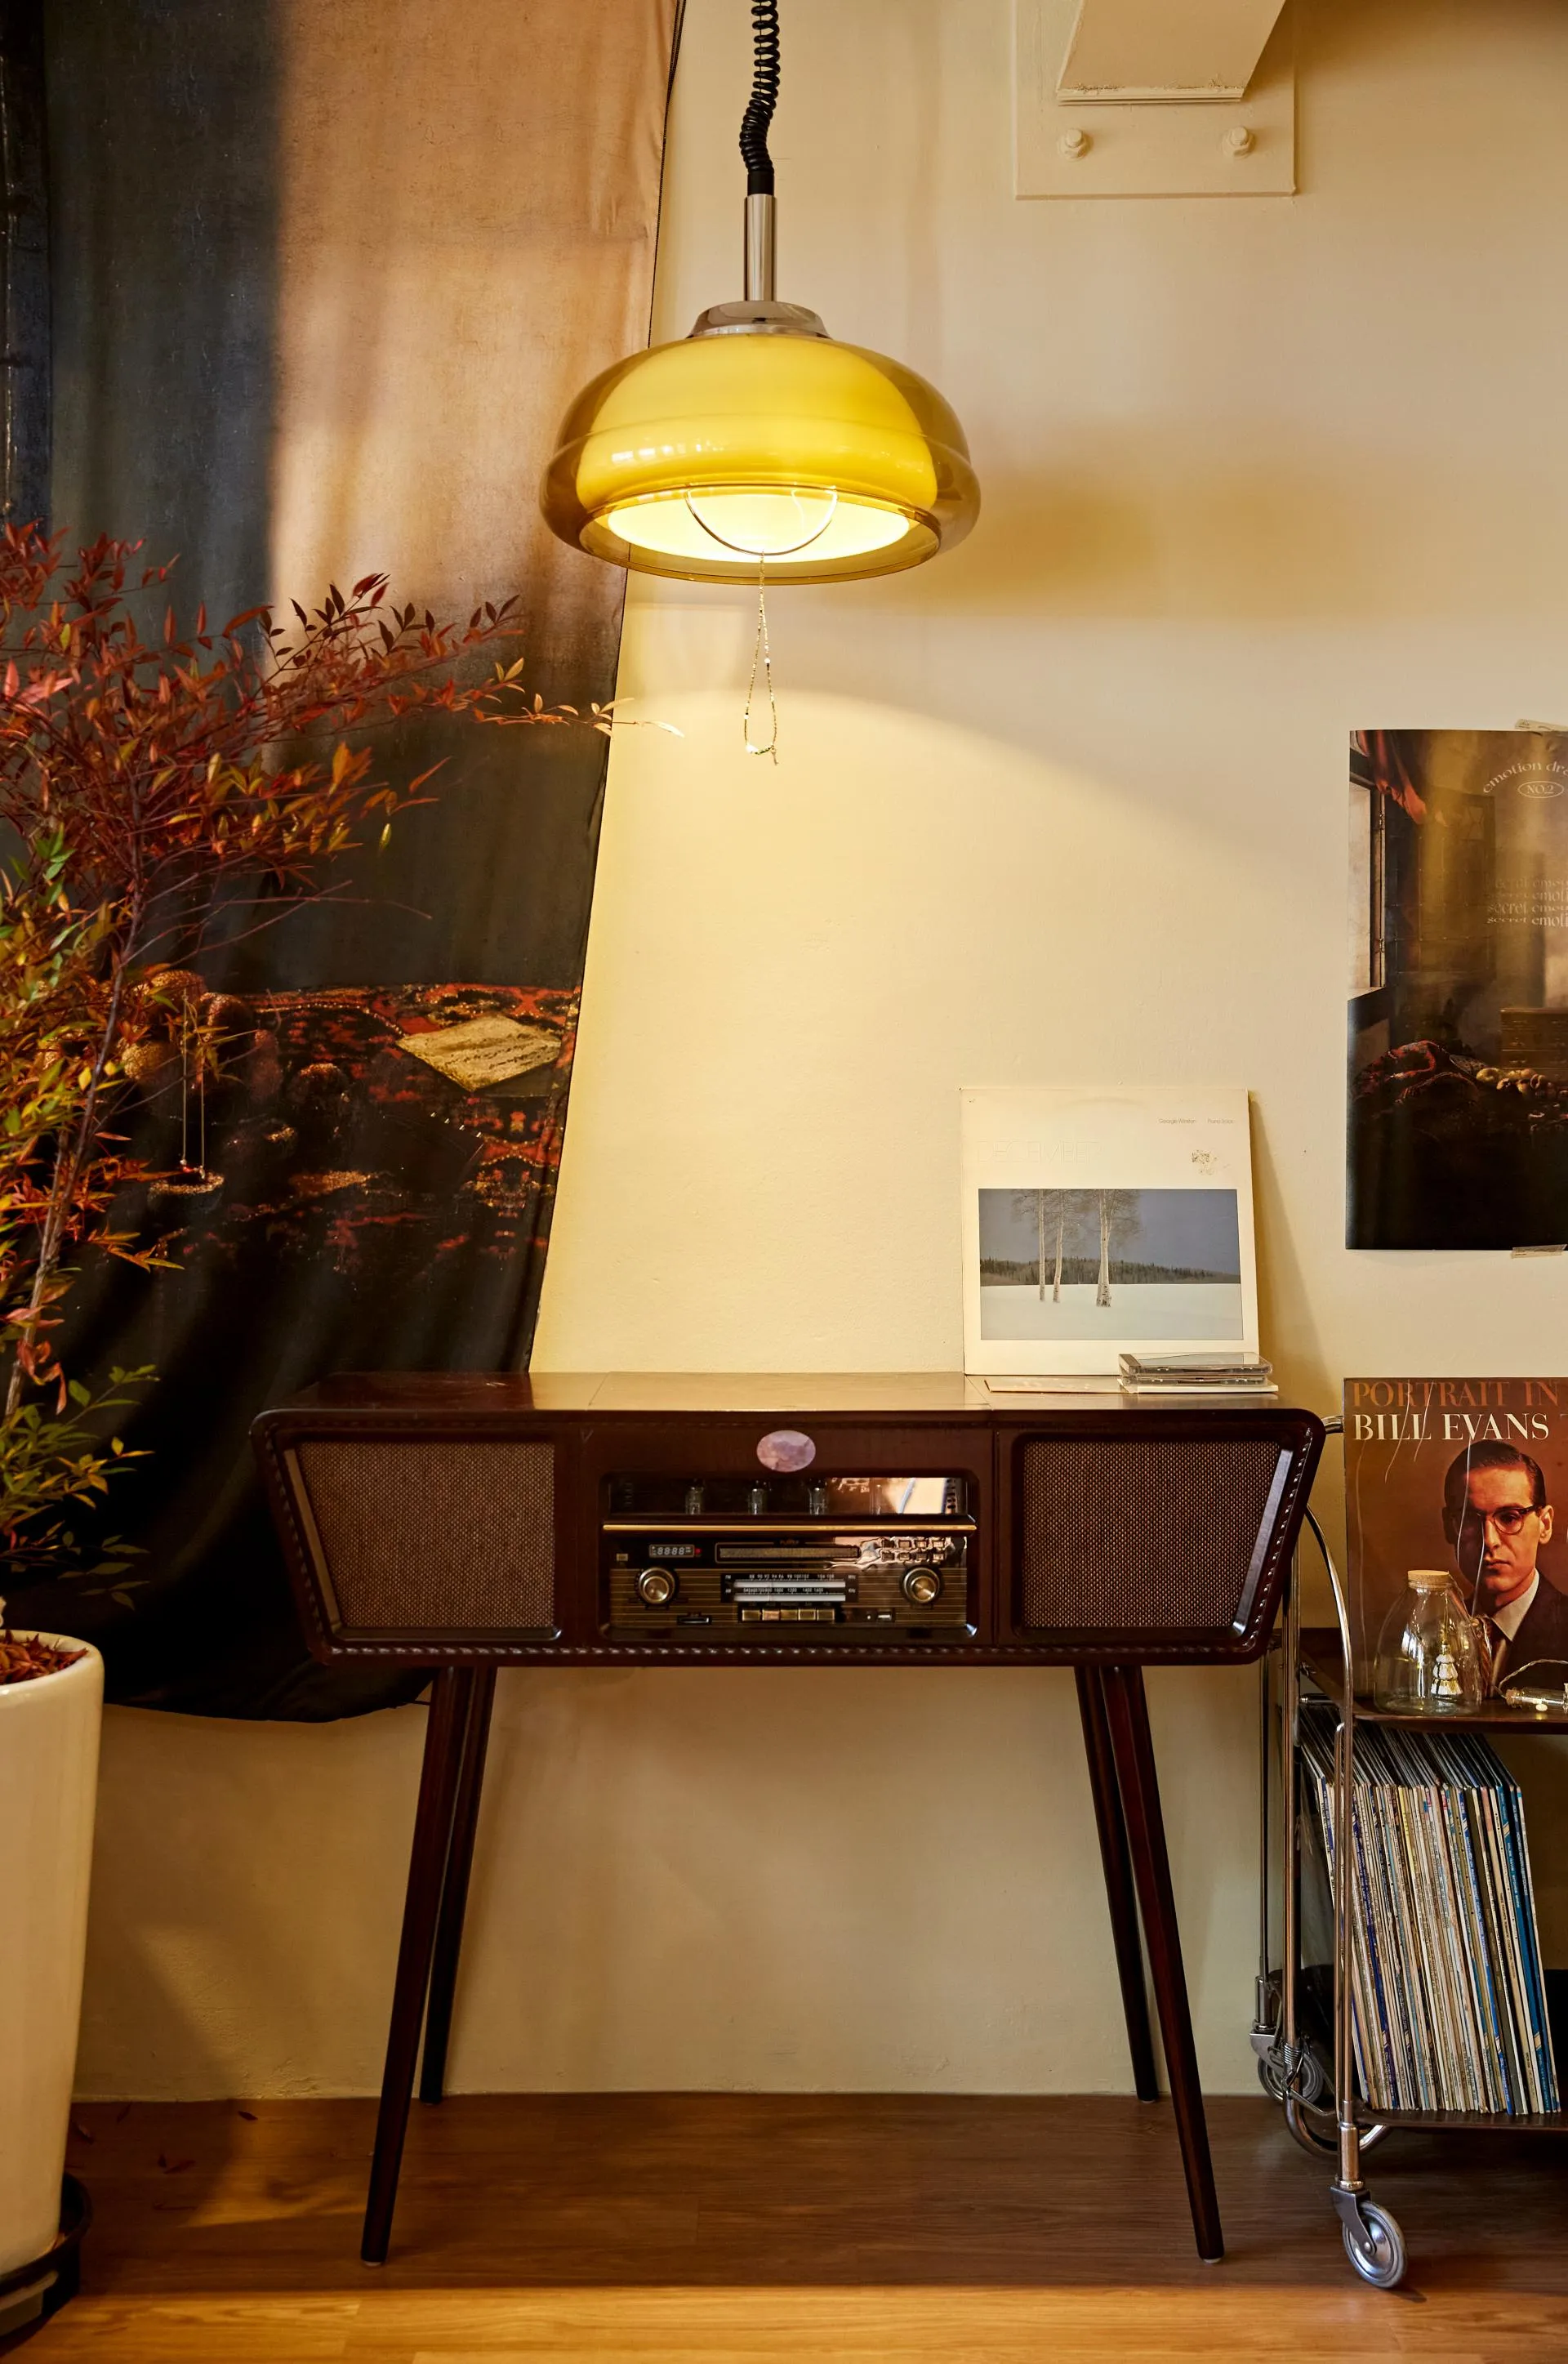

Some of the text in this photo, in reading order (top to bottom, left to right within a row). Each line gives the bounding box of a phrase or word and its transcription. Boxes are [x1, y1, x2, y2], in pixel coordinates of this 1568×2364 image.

[1483, 763, 1542, 793] emotion
[1353, 1381, 1560, 1407] PORTRAIT IN
[1352, 1413, 1549, 1440] BILL EVANS
